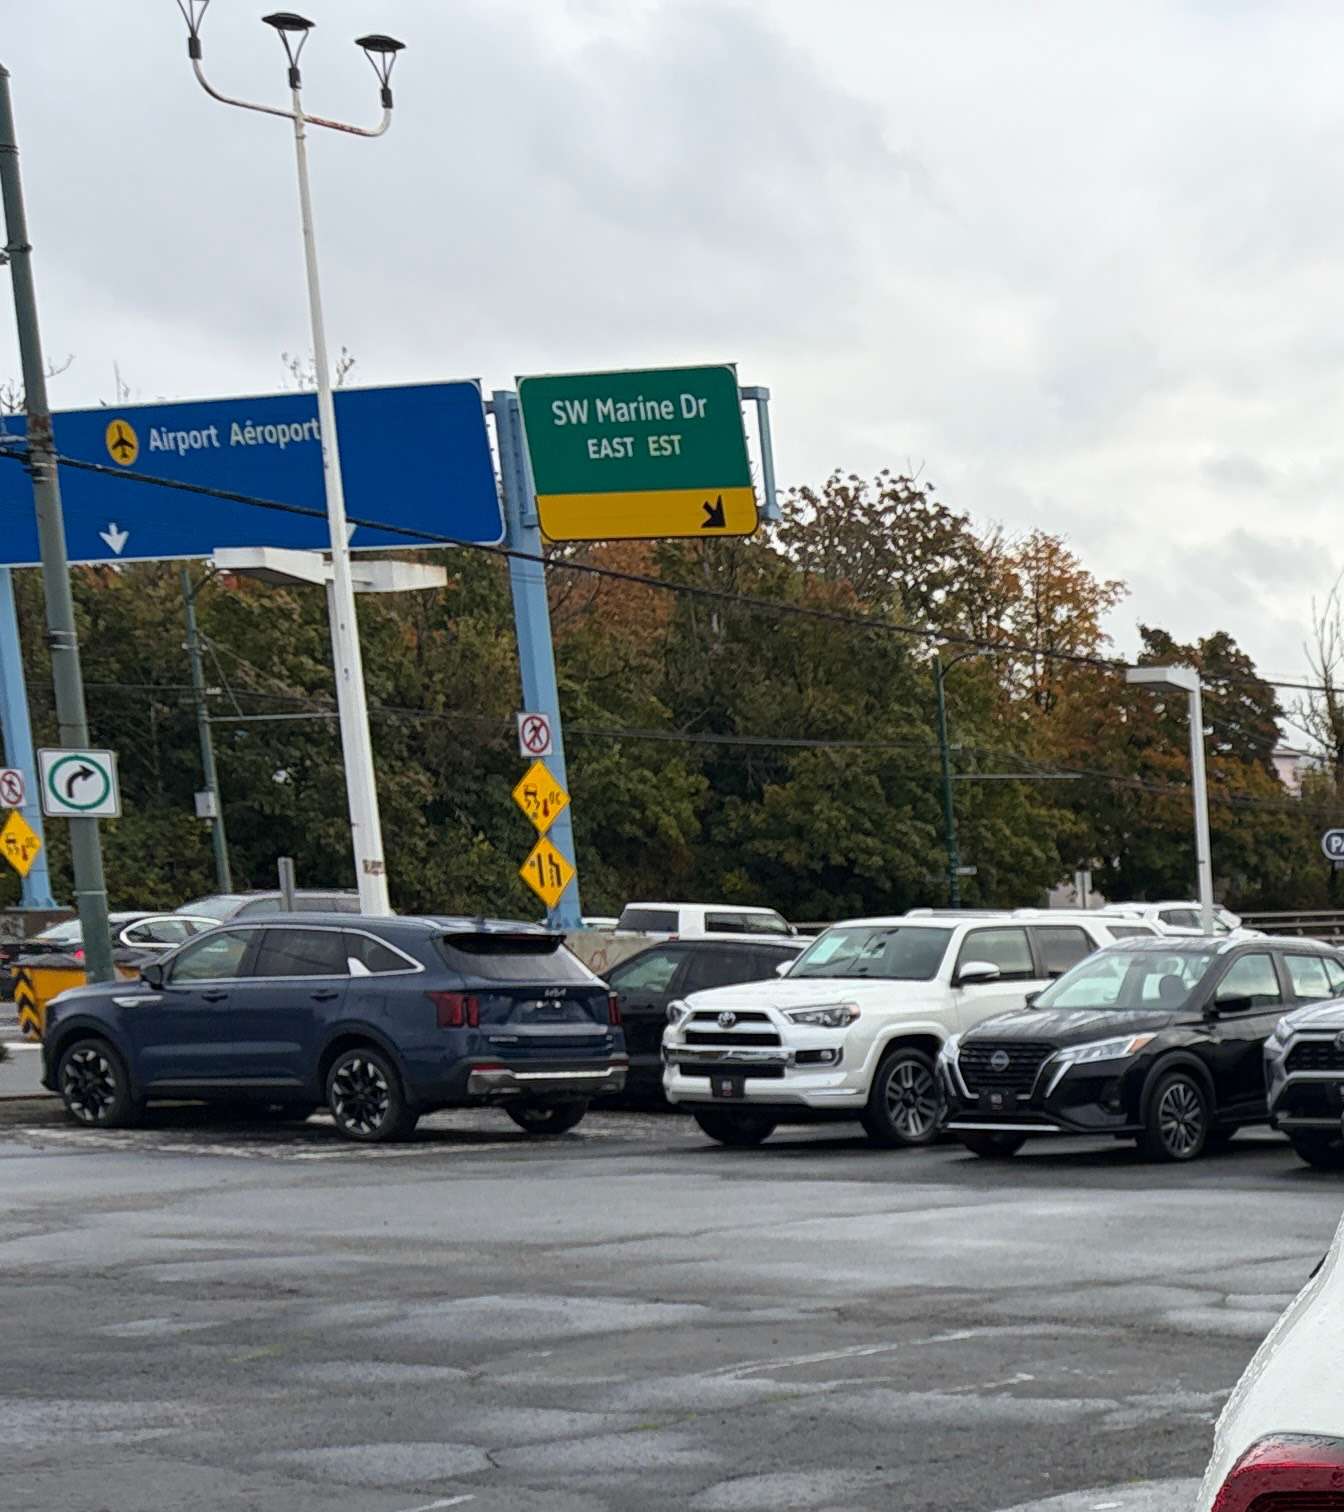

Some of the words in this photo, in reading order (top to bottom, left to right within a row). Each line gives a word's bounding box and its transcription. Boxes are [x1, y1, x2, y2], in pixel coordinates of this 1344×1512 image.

[551, 399, 588, 425] SW
[595, 395, 675, 423] Marine
[680, 393, 708, 419] Dr
[150, 425, 221, 457] Airport
[230, 417, 322, 449] Aéroport
[587, 437, 635, 459] EAST
[647, 434, 682, 457] EST
